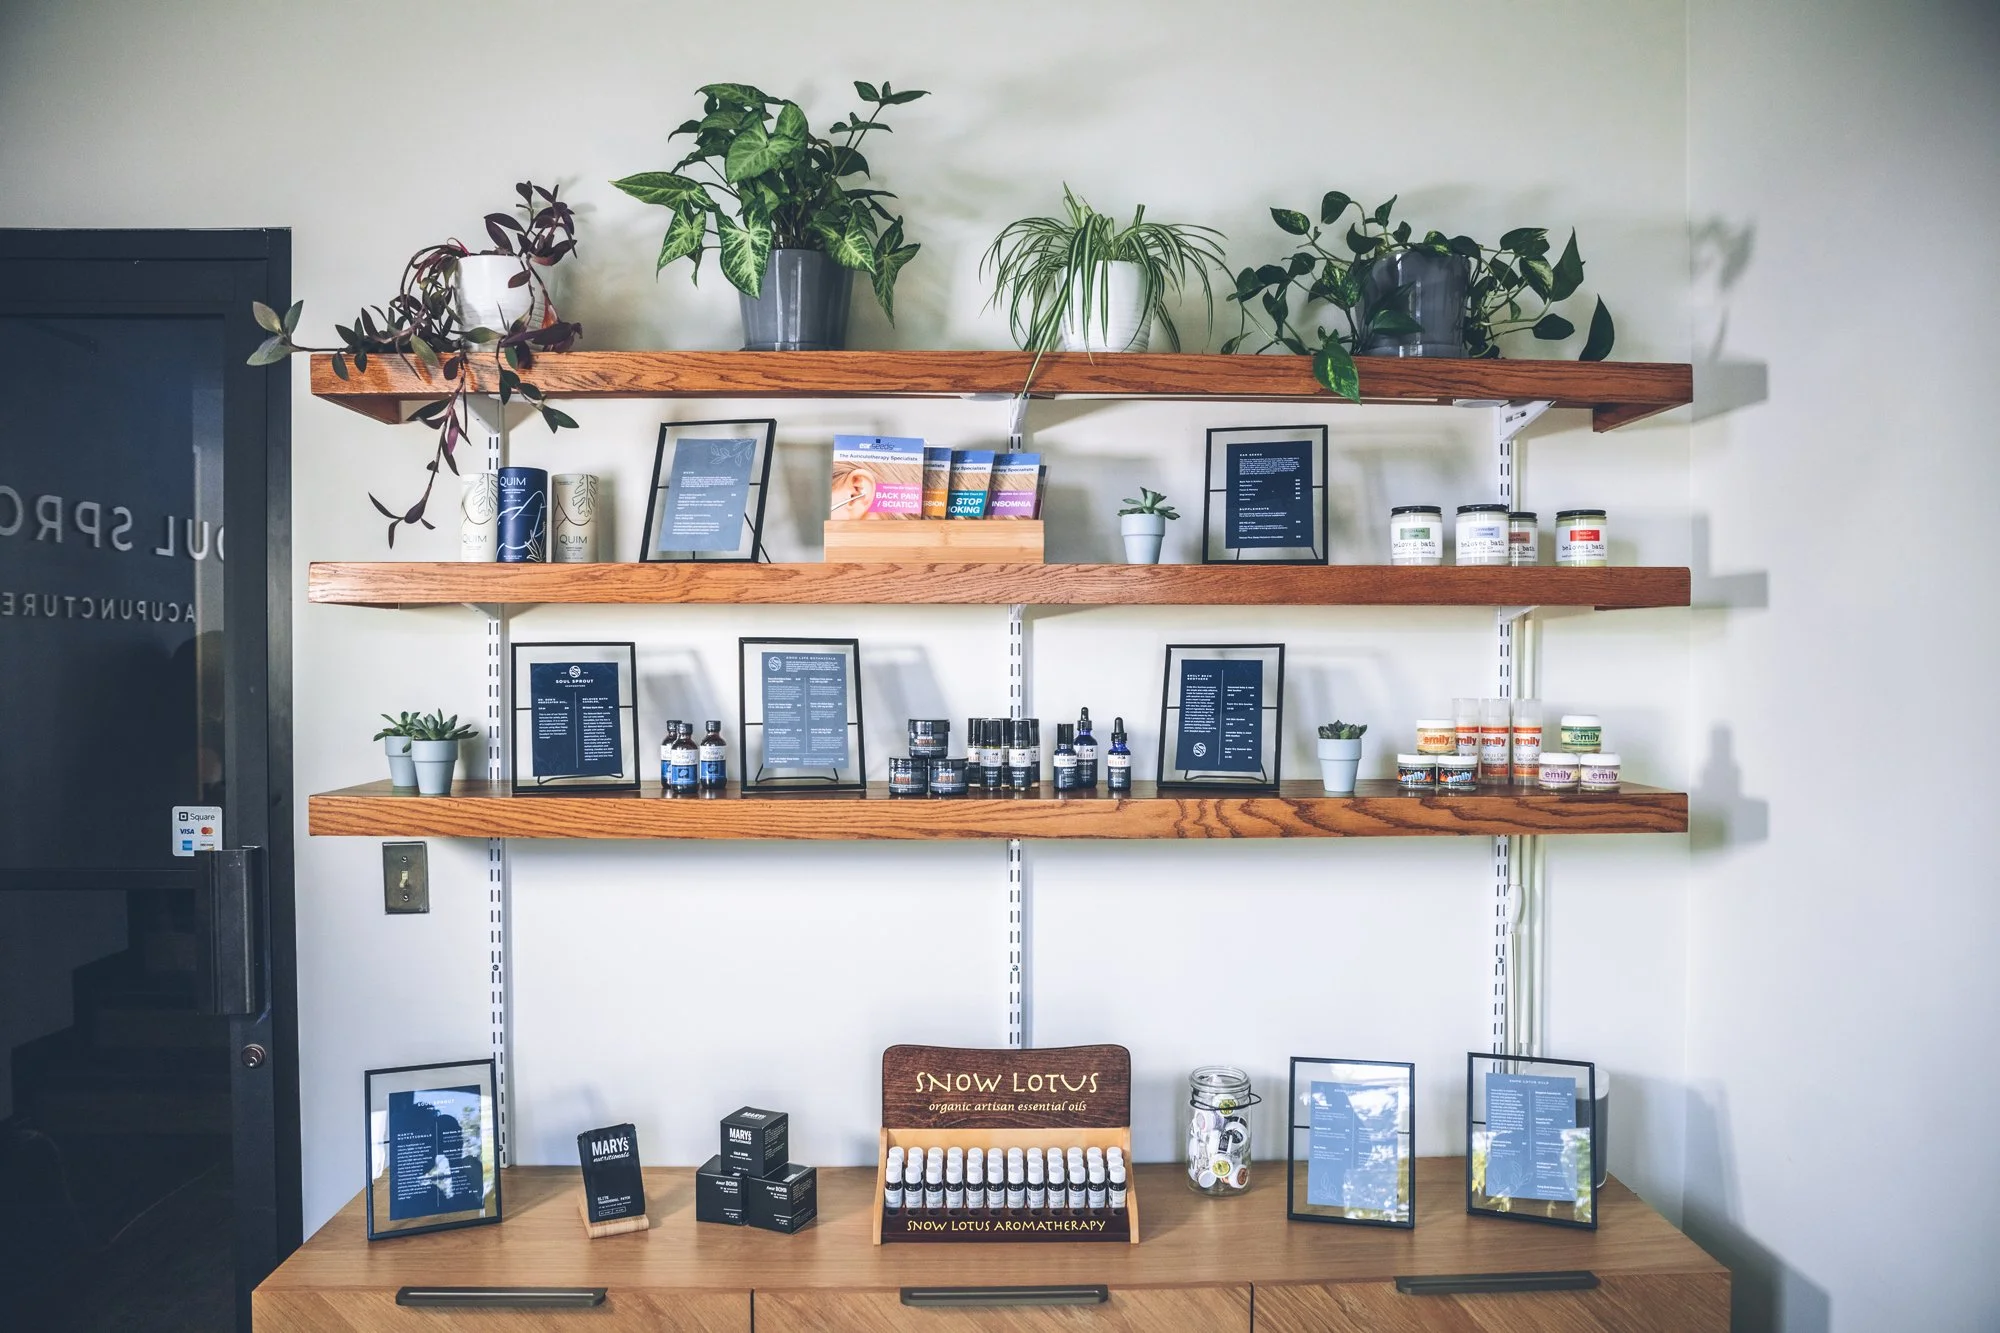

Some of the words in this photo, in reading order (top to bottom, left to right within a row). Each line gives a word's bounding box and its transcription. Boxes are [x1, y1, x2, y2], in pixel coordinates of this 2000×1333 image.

[500, 476, 526, 487] QUIM
[875, 491, 898, 499] BACK
[882, 500, 919, 508] SCIATICA
[956, 497, 983, 505] STOP
[948, 506, 980, 514] OKING
[462, 534, 487, 544] QUIM
[560, 534, 588, 545] QUIM
[1423, 735, 1450, 745] emily
[1481, 736, 1506, 747] emily
[1515, 736, 1540, 747] emily
[1573, 732, 1600, 742] emily
[1402, 771, 1426, 782] emily
[1447, 771, 1472, 782] emily
[1545, 770, 1572, 779] emily
[1592, 770, 1618, 780] emily
[189, 812, 215, 822] Square
[915, 1071, 1002, 1094] SNOW
[1012, 1071, 1099, 1094] LOTUS
[928, 1101, 971, 1112] organic
[973, 1101, 1015, 1112] artisan
[1017, 1100, 1067, 1112] essential
[1067, 1100, 1087, 1112] oils
[906, 1220, 948, 1232] SNOW
[951, 1220, 990, 1232] LOTUS
[994, 1219, 1106, 1232] AROMATHERAPY
